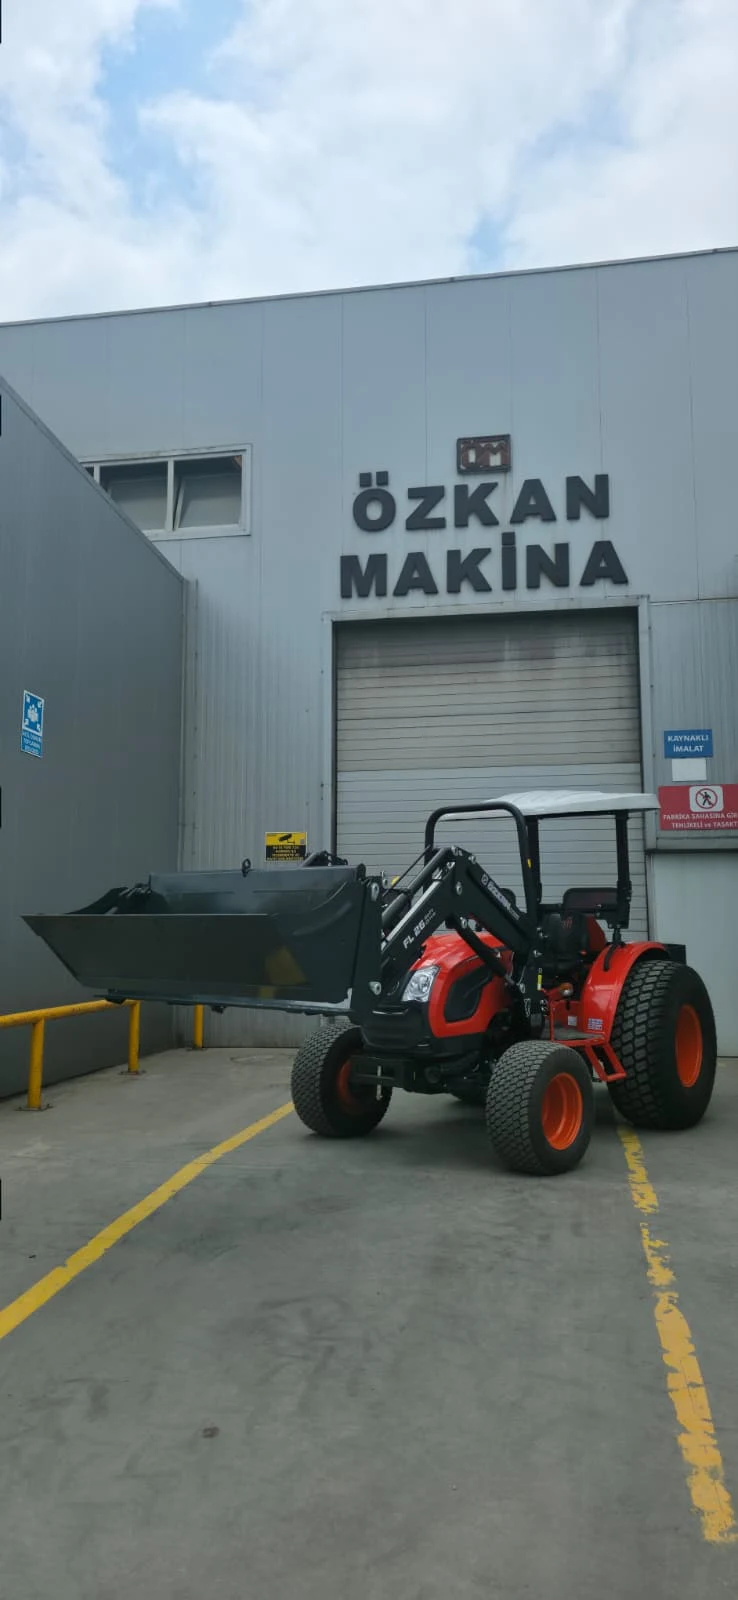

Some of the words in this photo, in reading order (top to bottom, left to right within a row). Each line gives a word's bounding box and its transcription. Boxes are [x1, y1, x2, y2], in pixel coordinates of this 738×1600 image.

[353, 471, 610, 532] ÖZKAN
[340, 532, 628, 598] MAKİNA
[667, 734, 709, 742] KAYNAKLI
[673, 744, 704, 752] İMALAT
[403, 935, 415, 949] FL
